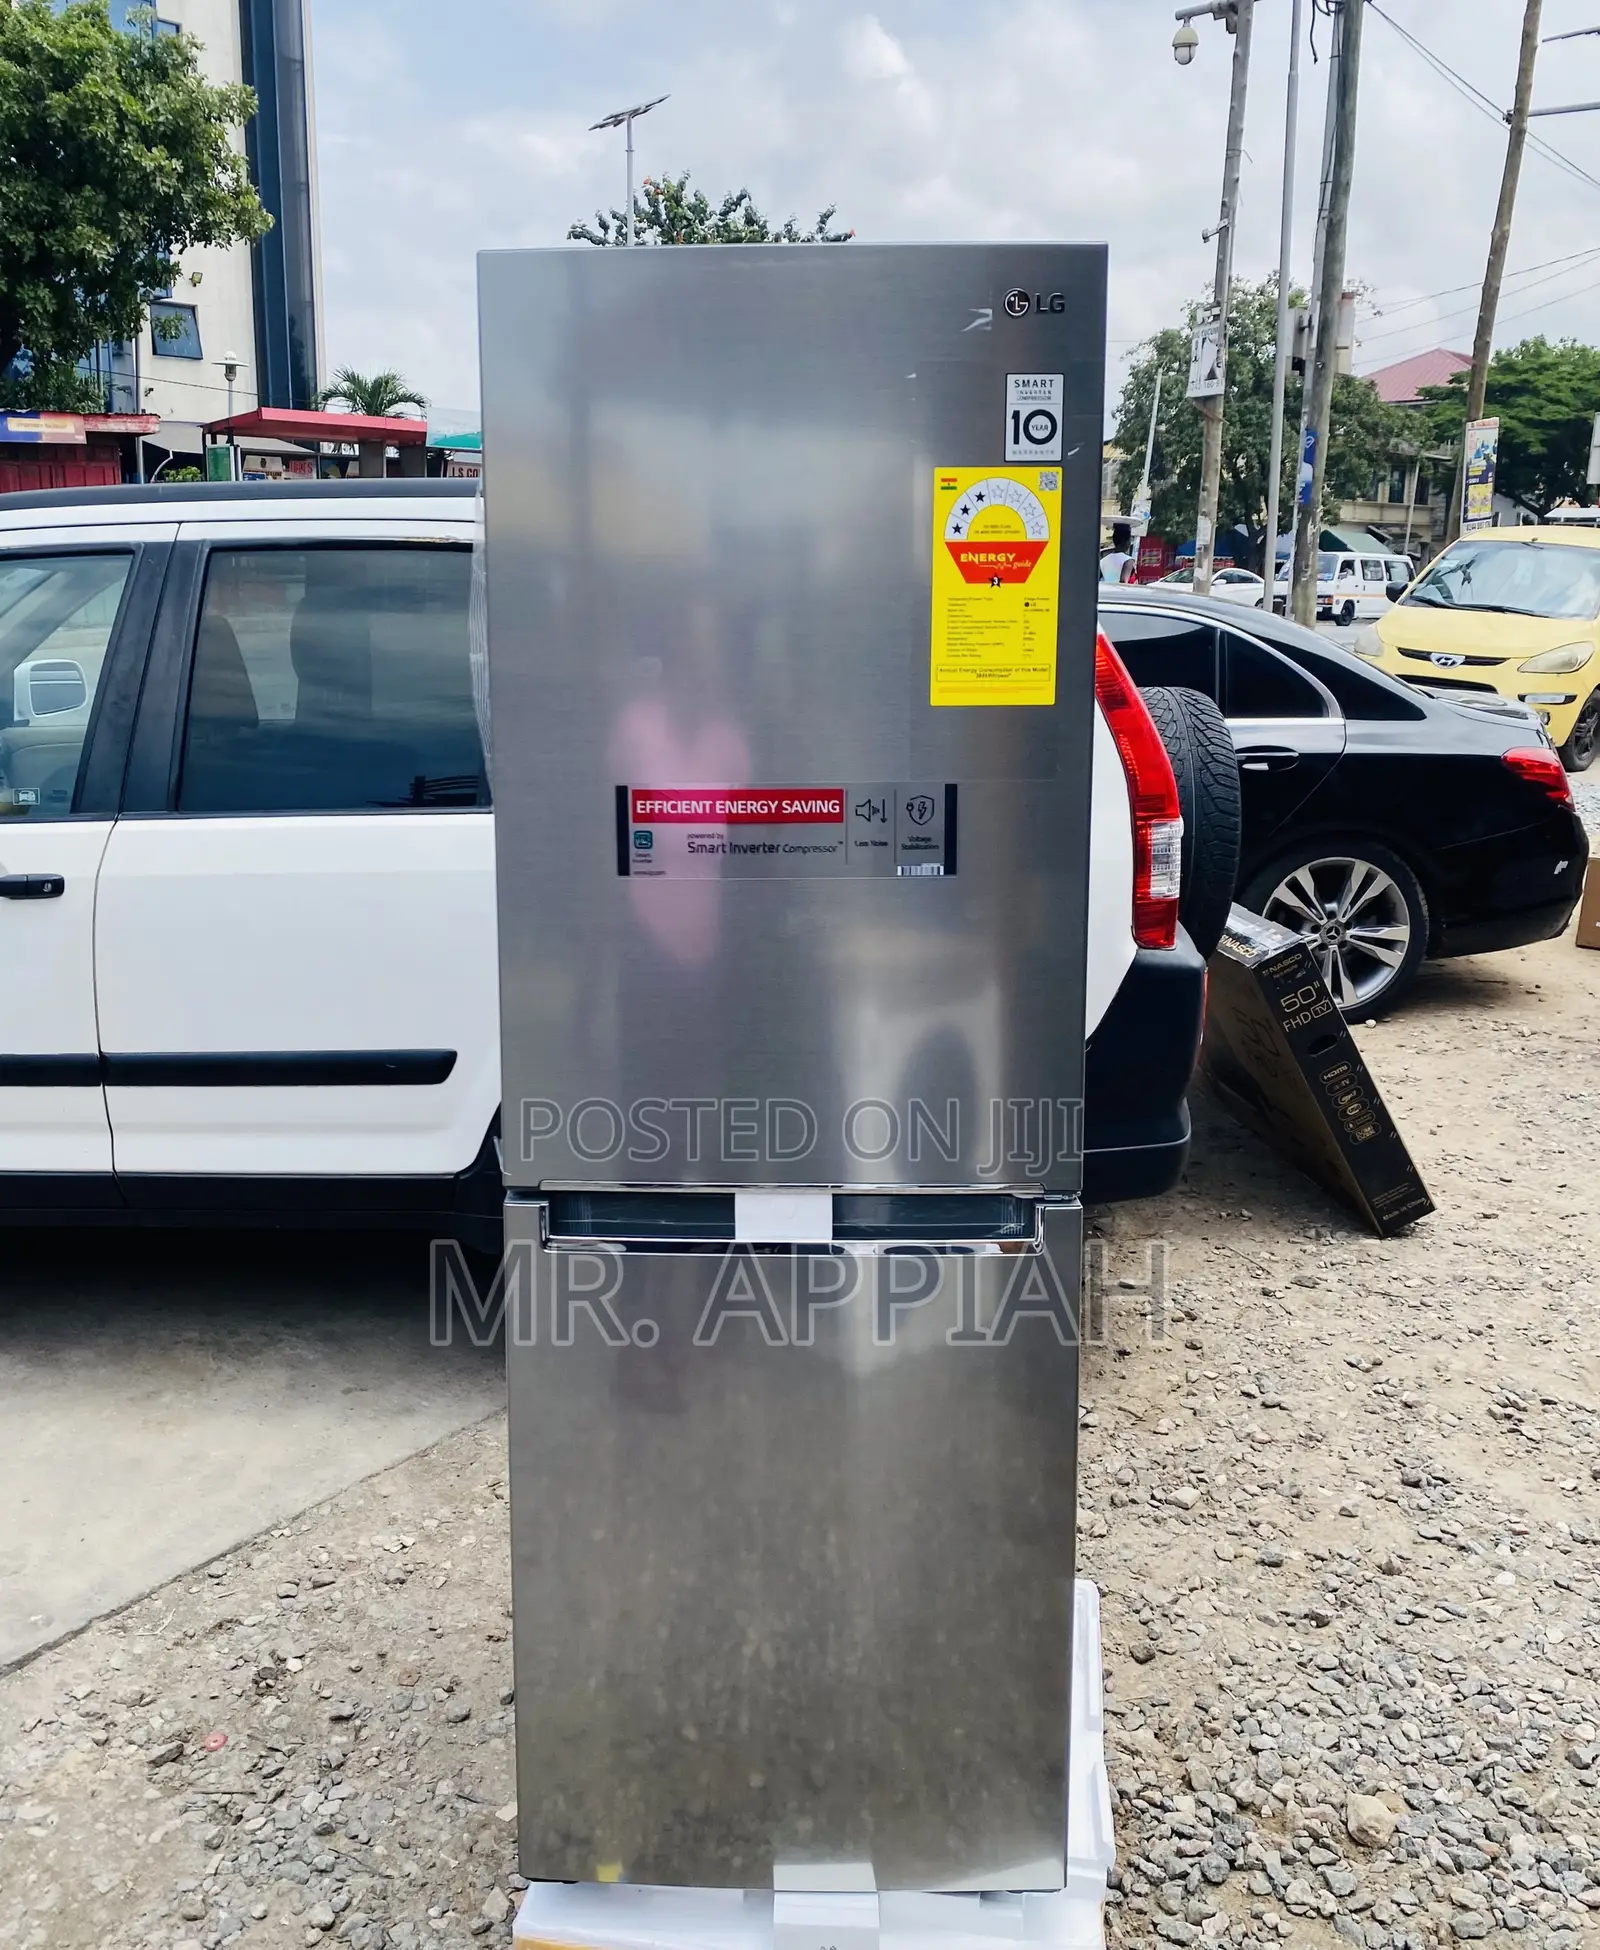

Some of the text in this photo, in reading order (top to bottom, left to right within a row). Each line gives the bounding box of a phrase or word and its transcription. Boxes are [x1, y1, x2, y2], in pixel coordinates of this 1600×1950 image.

[1035, 293, 1066, 314] LG
[1014, 379, 1055, 389] SMART
[1011, 408, 1058, 446] 10
[1031, 424, 1049, 432] YEAR
[960, 552, 1016, 565] ENERGY
[636, 799, 840, 815] EFFICIENT ENERGY SAVING
[687, 832, 724, 840] powered by
[907, 836, 932, 844] Voltage
[687, 841, 727, 854] Smart
[729, 841, 782, 854] Inverter
[1225, 937, 1258, 959] NASCO
[1269, 953, 1303, 974] NASCO
[1280, 980, 1321, 1013] 50"
[1282, 1011, 1312, 1033] FHD
